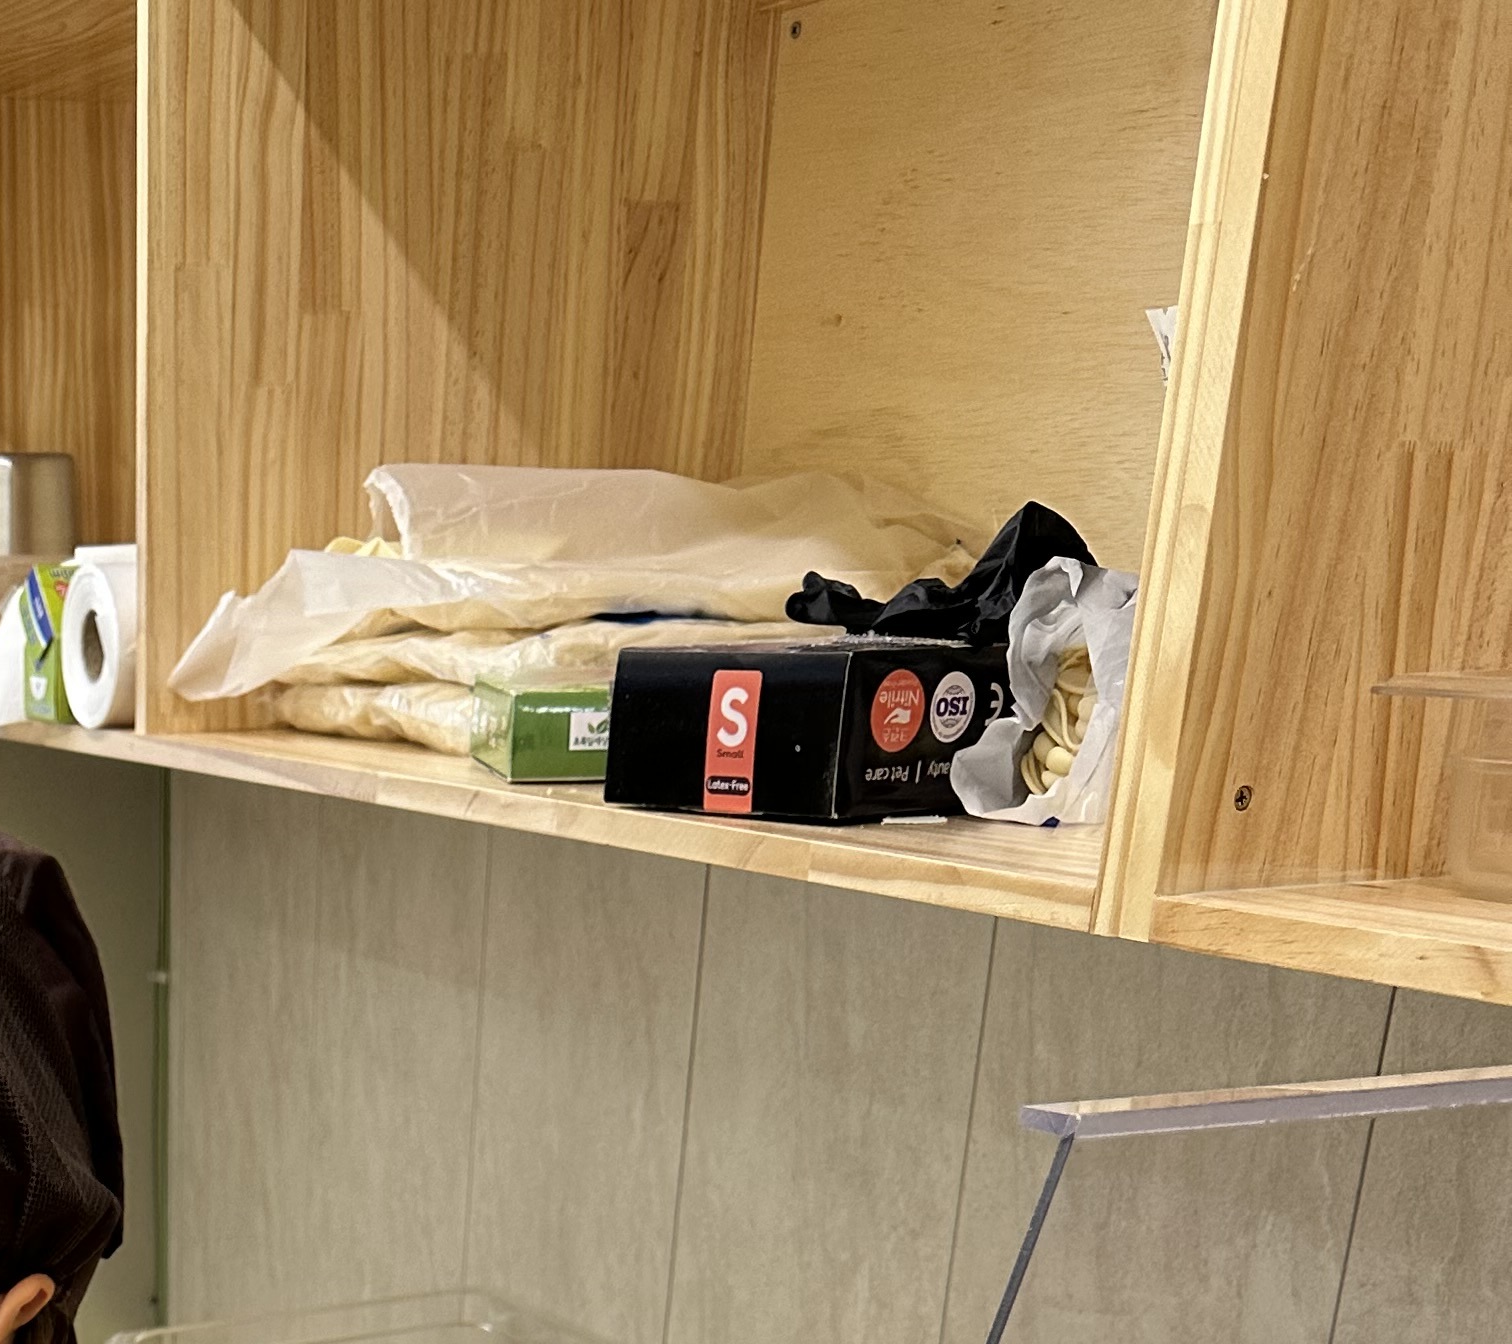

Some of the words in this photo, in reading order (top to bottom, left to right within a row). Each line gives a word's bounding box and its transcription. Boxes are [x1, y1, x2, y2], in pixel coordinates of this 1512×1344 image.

[879, 690, 920, 708] Nitrile
[936, 696, 969, 717] ISO
[716, 687, 749, 747] S
[716, 749, 745, 759] Small
[927, 760, 951, 778] auty
